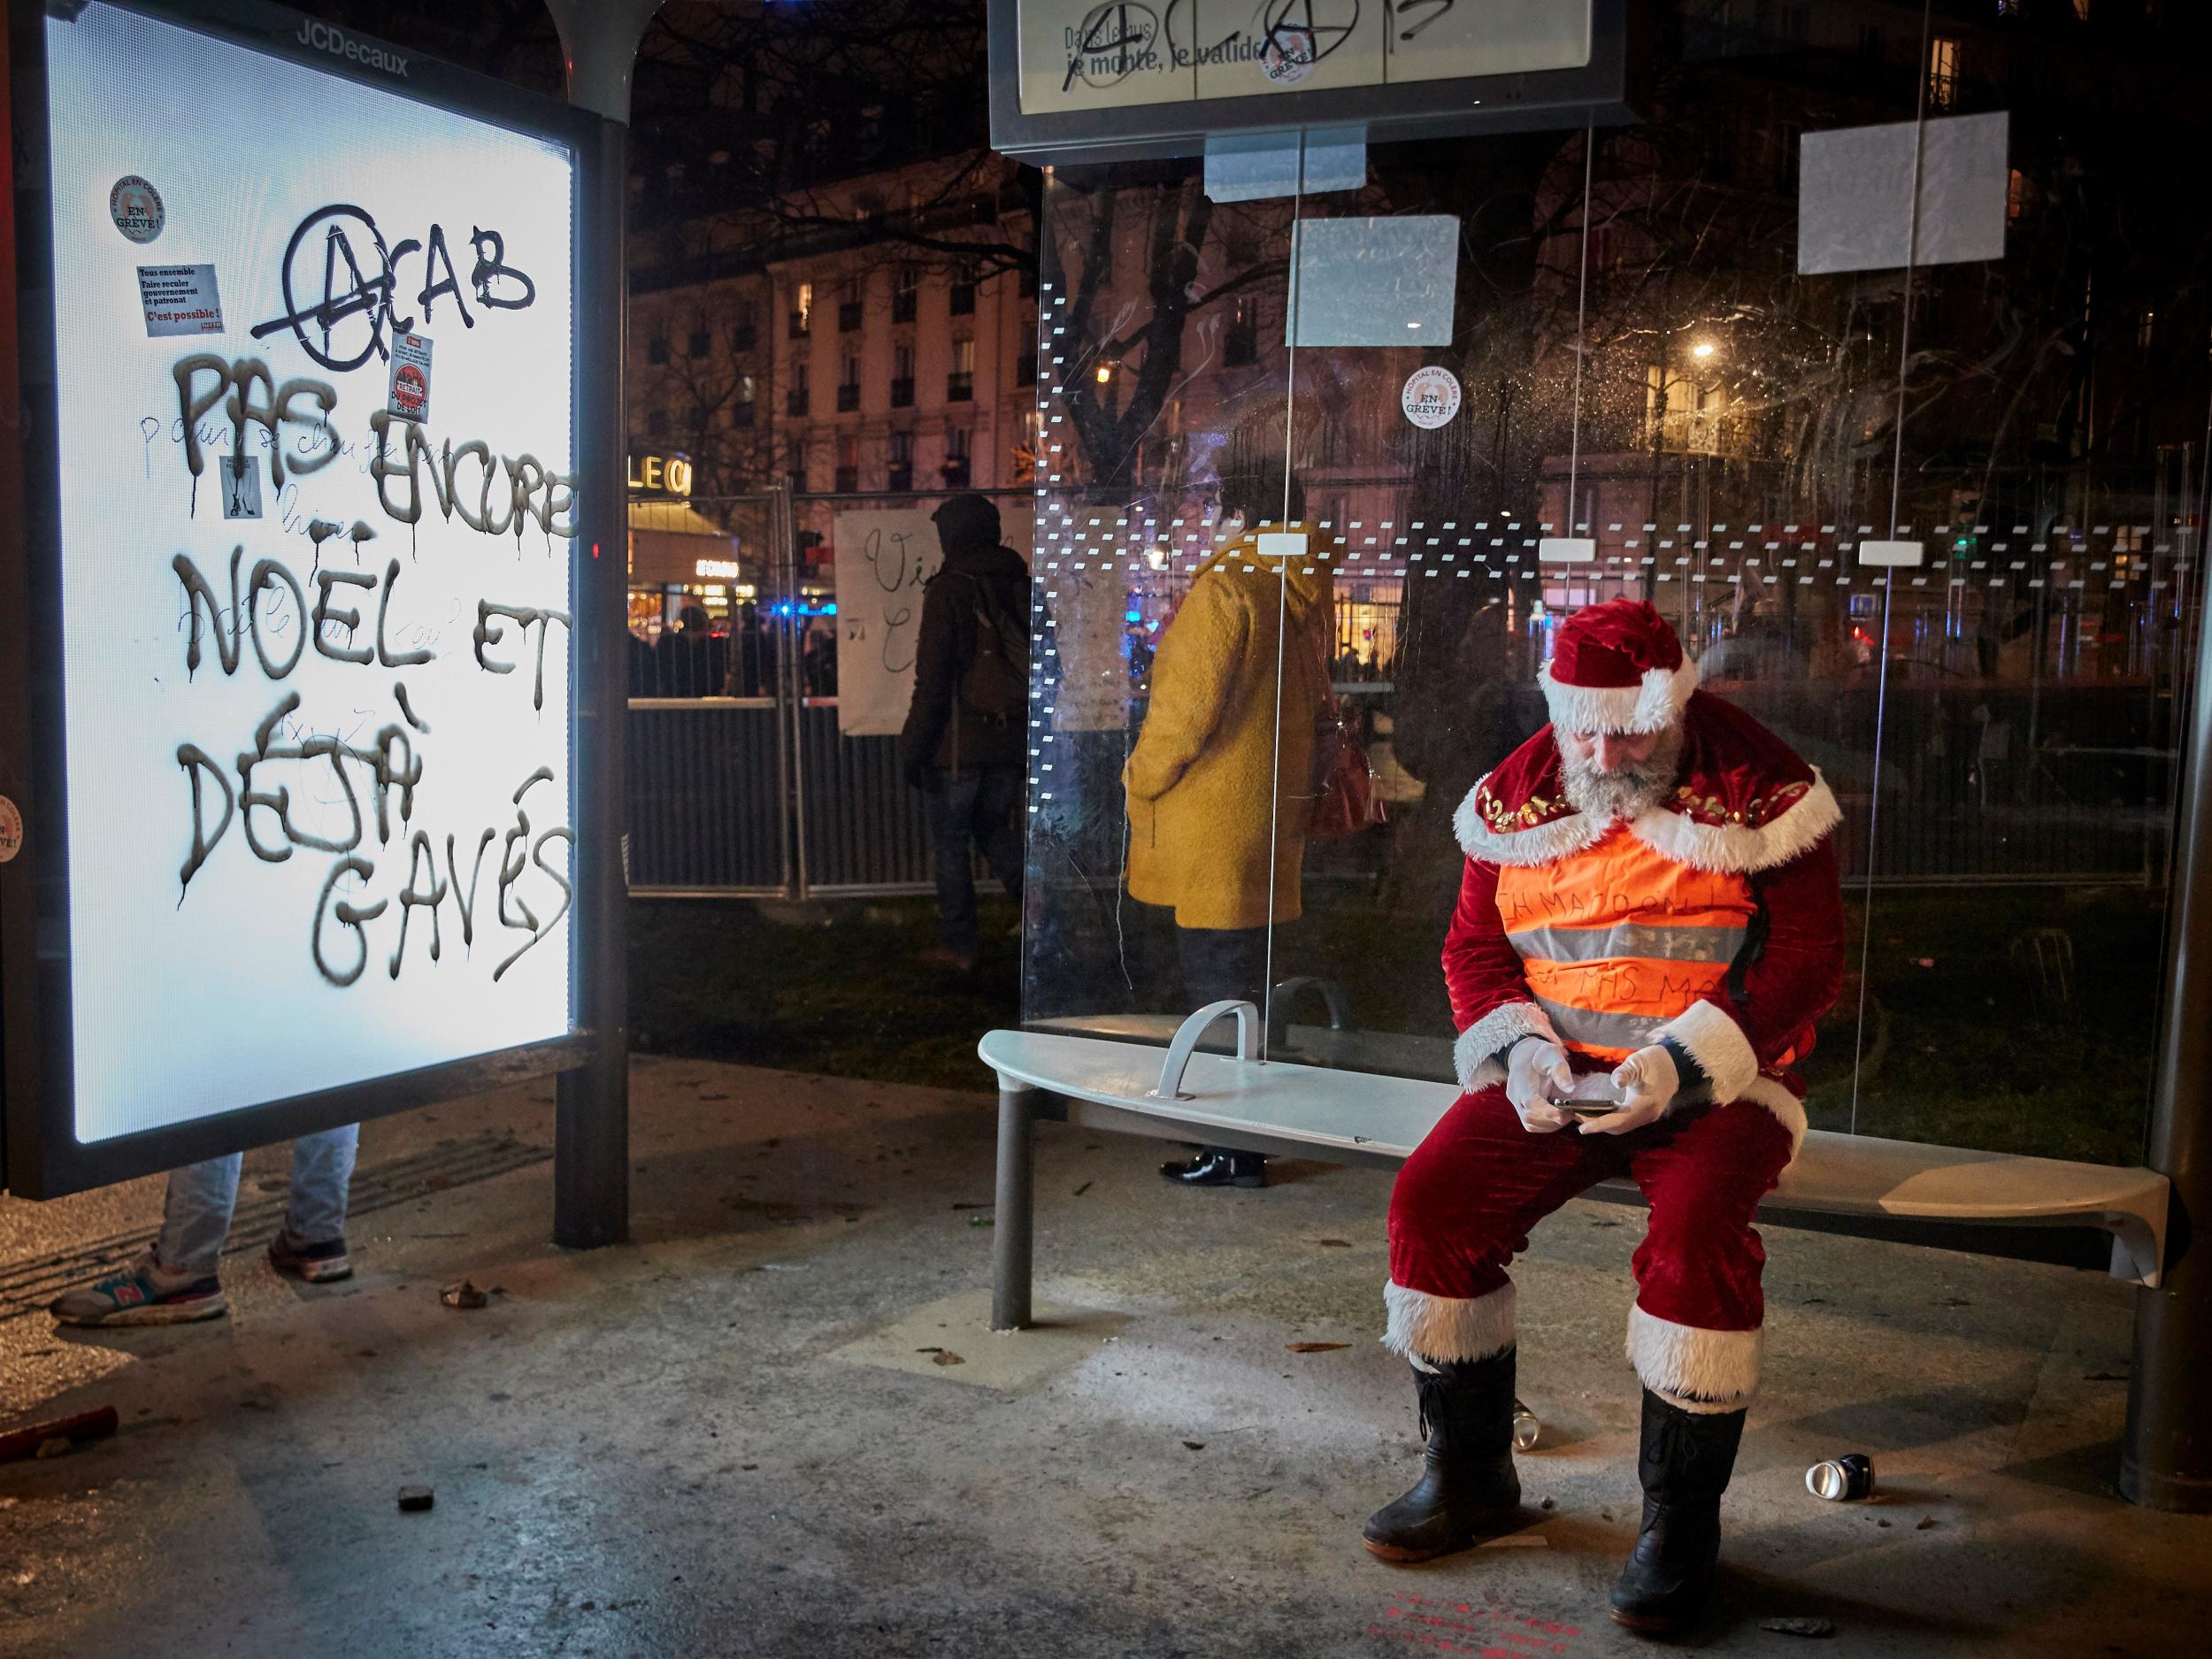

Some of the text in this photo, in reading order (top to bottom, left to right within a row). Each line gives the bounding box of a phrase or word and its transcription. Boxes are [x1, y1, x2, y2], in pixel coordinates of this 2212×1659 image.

[1064, 26, 1103, 49] Dans
[296, 19, 410, 78] JCDecaux
[1090, 49, 1164, 75] monte,
[1171, 43, 1189, 72] je
[131, 178, 142, 187] EN
[127, 206, 144, 216] EN
[139, 267, 196, 277] Tous ensemble
[162, 279, 189, 288] reculer
[250, 202, 535, 373] ACAB
[143, 288, 199, 299] gouvernement
[153, 296, 187, 307] patronat
[147, 311, 173, 322] C'est
[173, 308, 214, 323] possible
[399, 382, 421, 395] RETRAIT
[1421, 394, 1438, 403] EN
[173, 352, 340, 489] PAS
[473, 598, 572, 710] ET
[177, 681, 431, 885] DÉJÀ
[312, 766, 574, 987] GAVÉS
